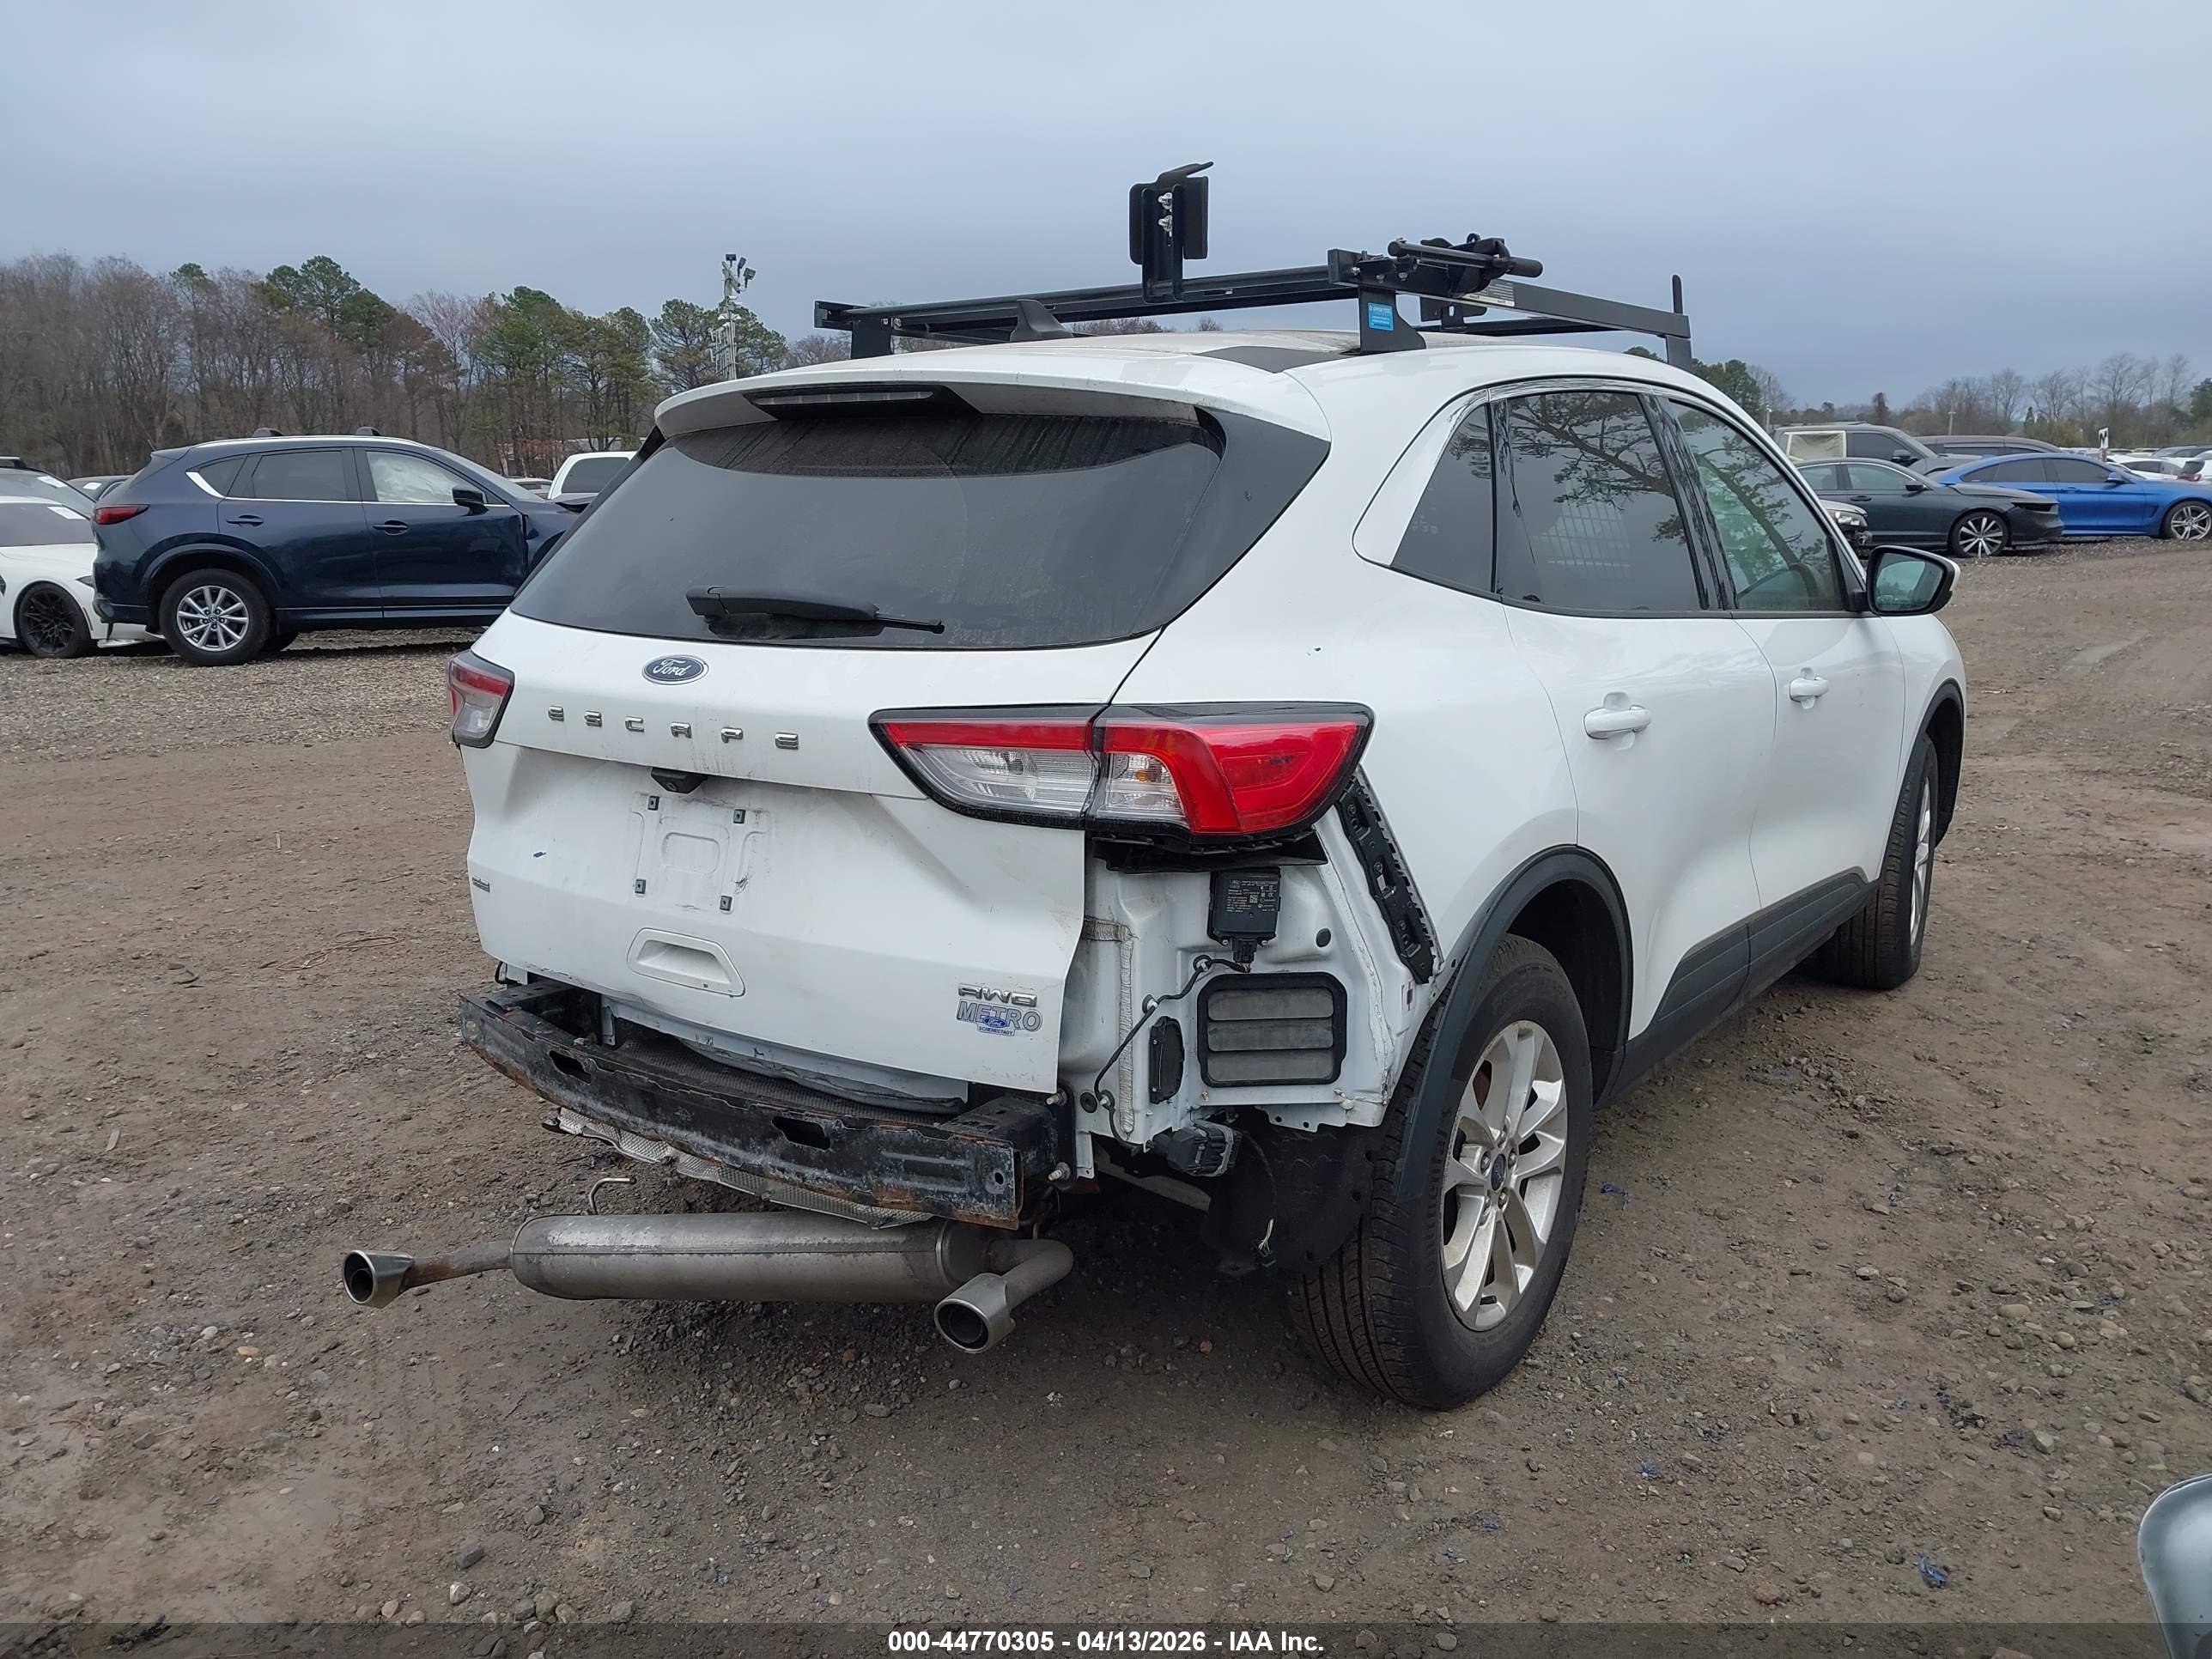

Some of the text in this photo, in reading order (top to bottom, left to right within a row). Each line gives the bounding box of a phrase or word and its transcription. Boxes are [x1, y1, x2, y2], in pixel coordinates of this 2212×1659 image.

[652, 658, 686, 677] Ford
[547, 705, 799, 750] ESCAPE
[958, 984, 1037, 1006] AWD
[957, 1000, 1042, 1032] METRO
